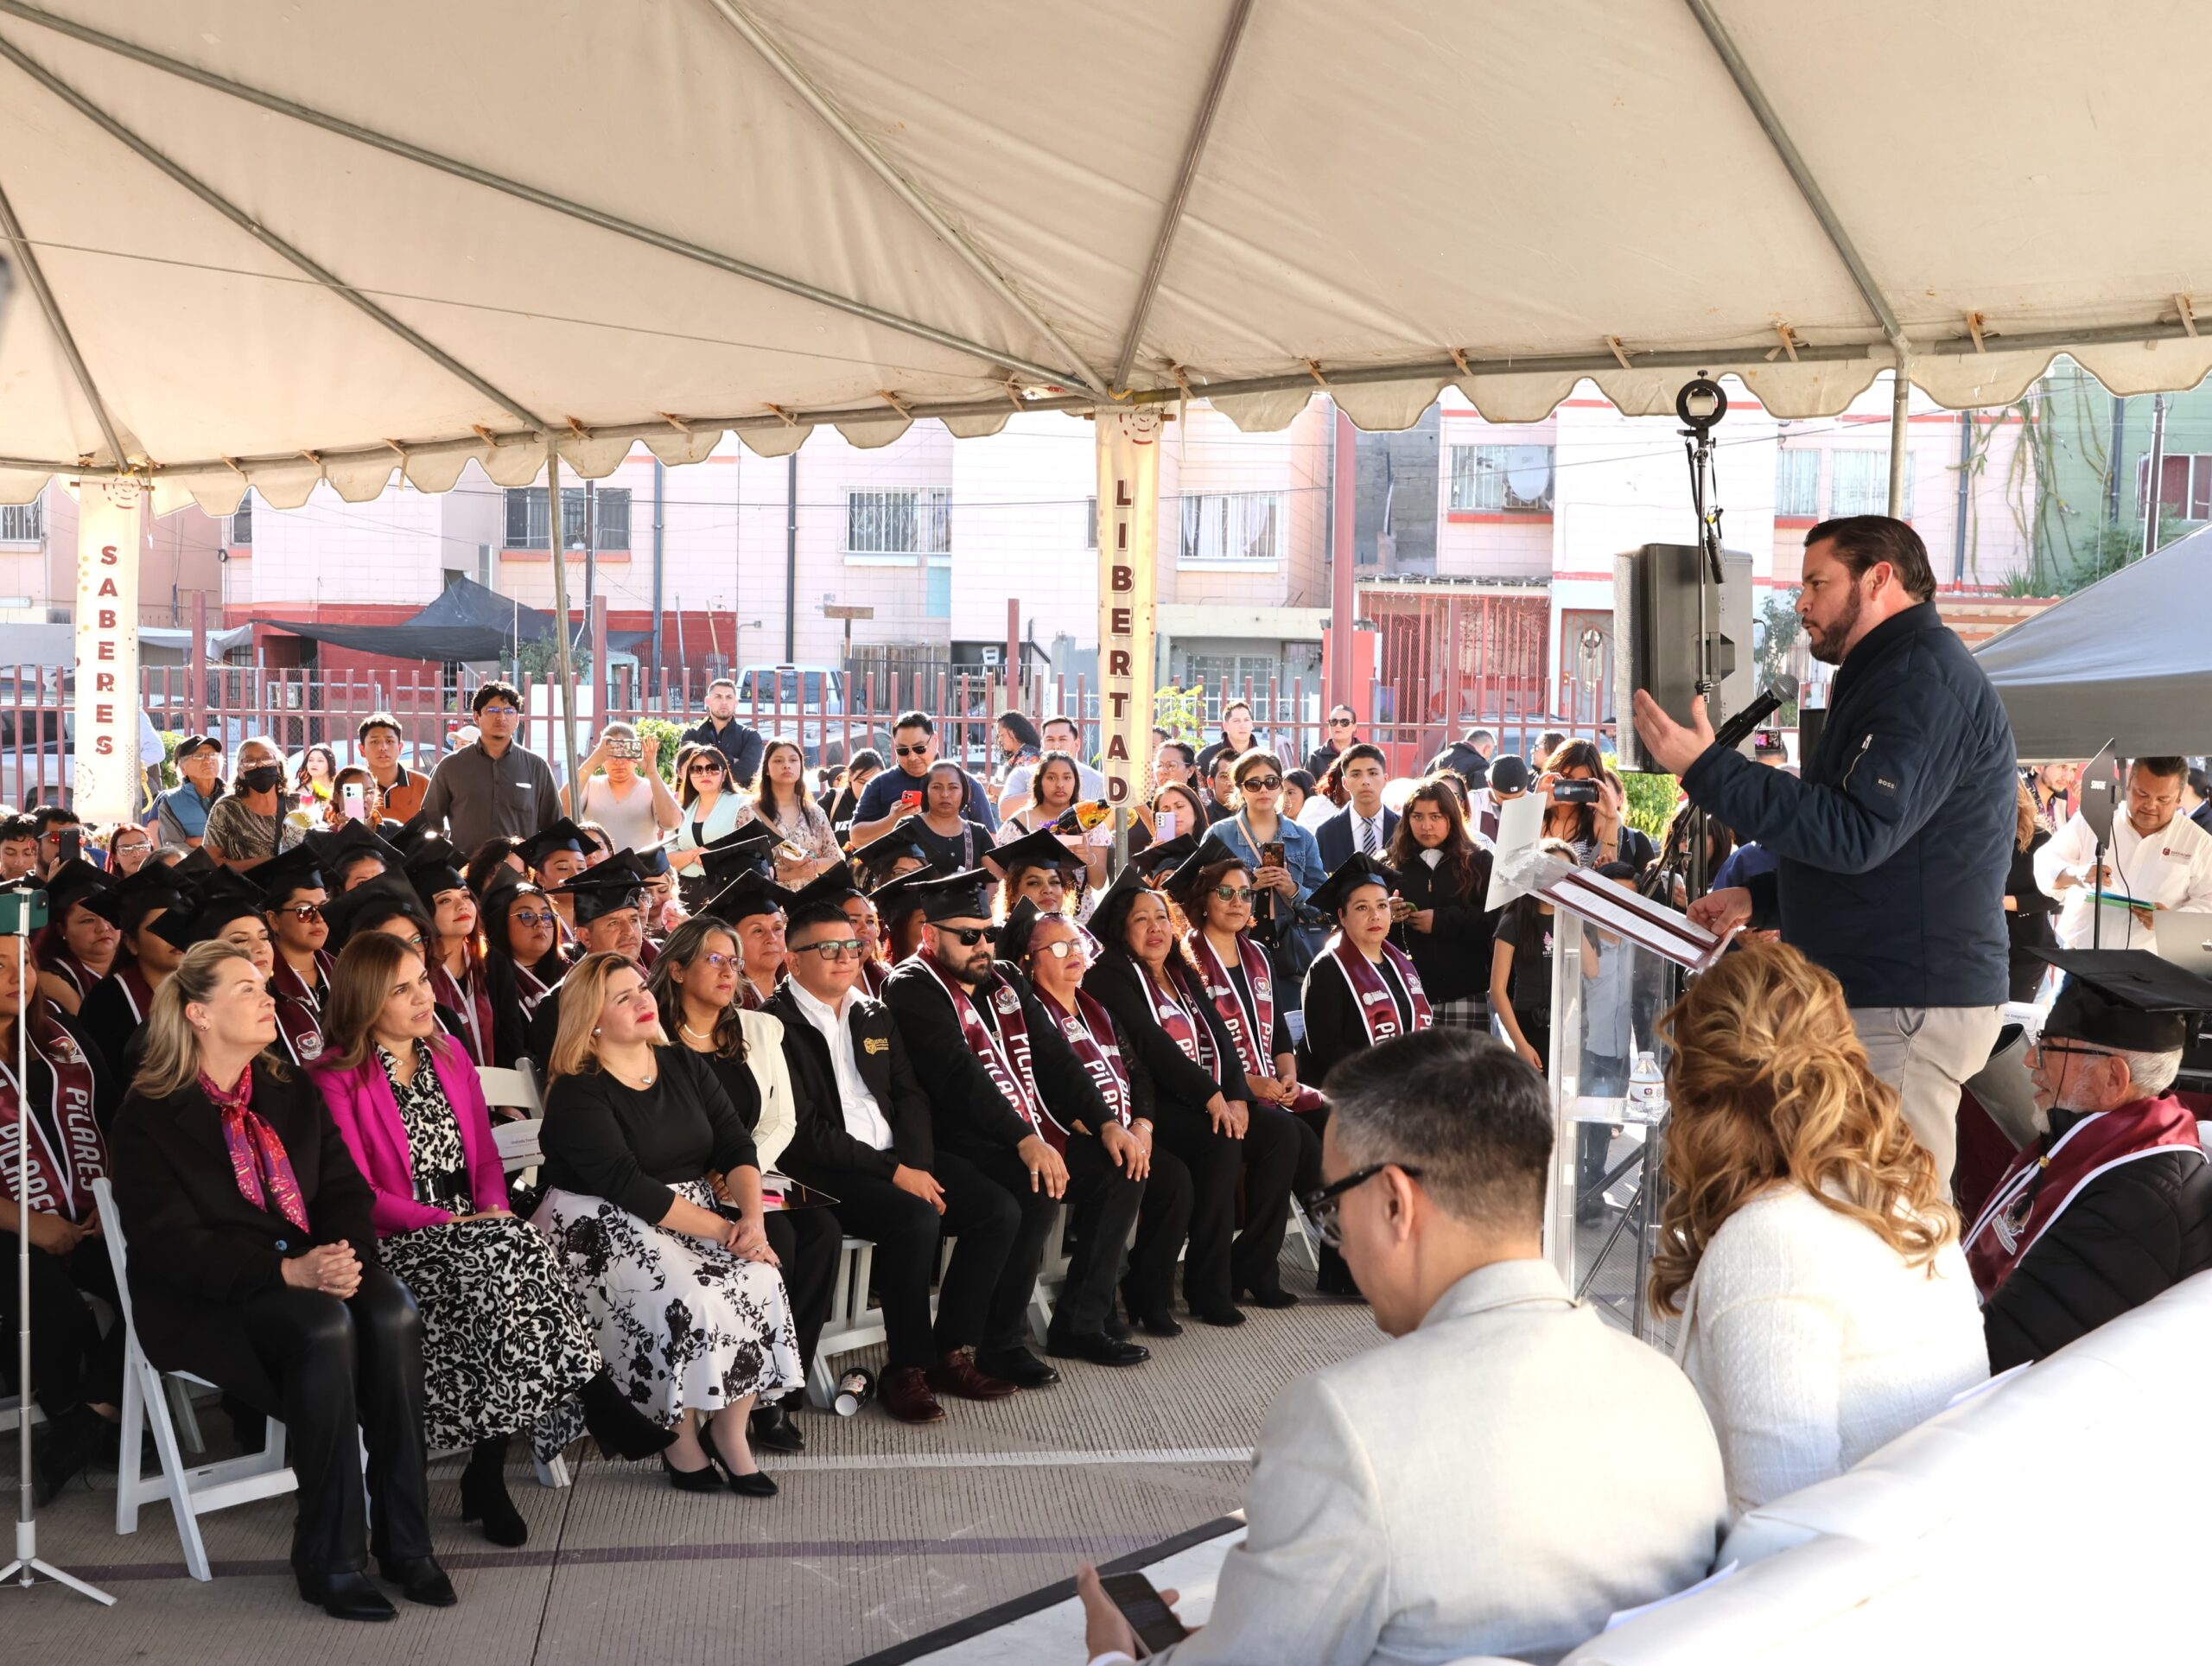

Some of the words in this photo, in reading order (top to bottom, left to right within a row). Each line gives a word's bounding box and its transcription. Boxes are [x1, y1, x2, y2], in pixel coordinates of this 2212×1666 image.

[95, 545, 118, 755] SABERES
[1109, 480, 1134, 805] LIBERTAD
[1878, 779, 1895, 789] BOSS
[66, 1087, 104, 1192] PiLARES
